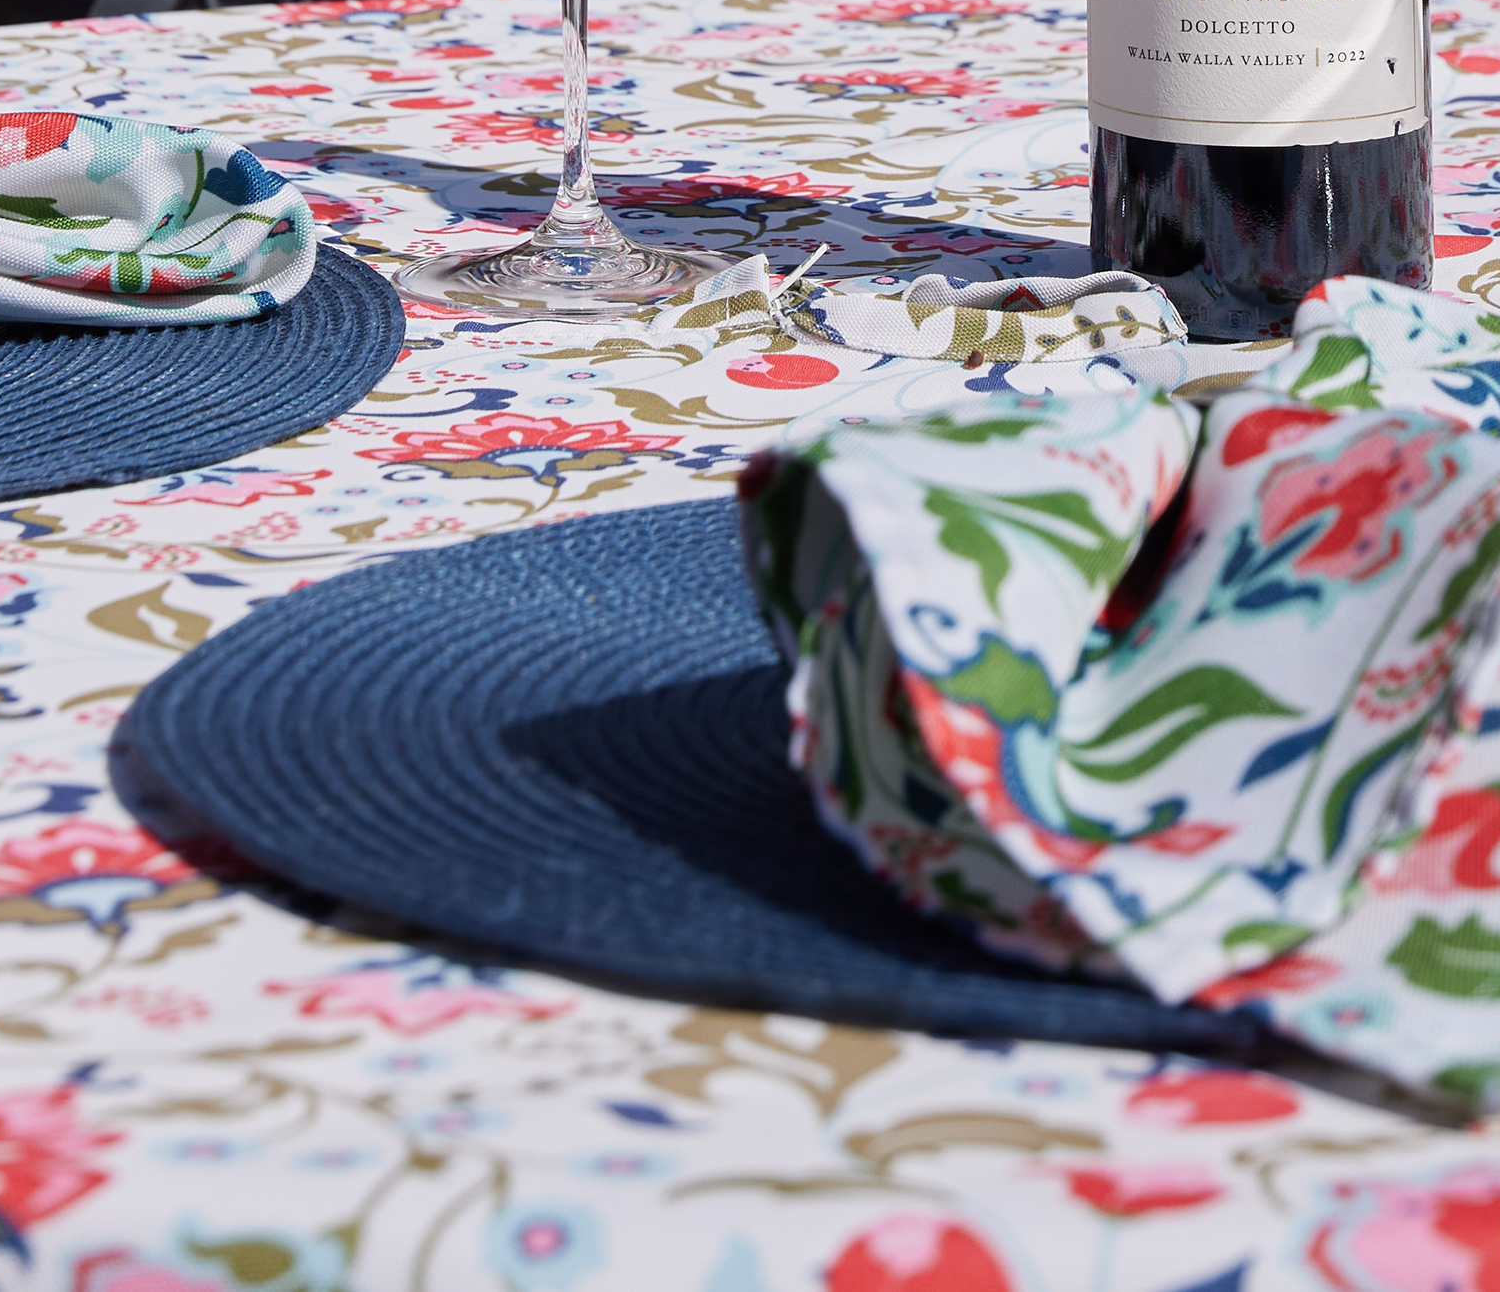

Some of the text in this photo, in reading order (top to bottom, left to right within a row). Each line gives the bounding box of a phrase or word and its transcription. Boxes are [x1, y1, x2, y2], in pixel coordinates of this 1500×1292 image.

[1180, 19, 1296, 35] DOLCETTO
[1127, 45, 1366, 66] WALLA WALLA VALLEY 2022
